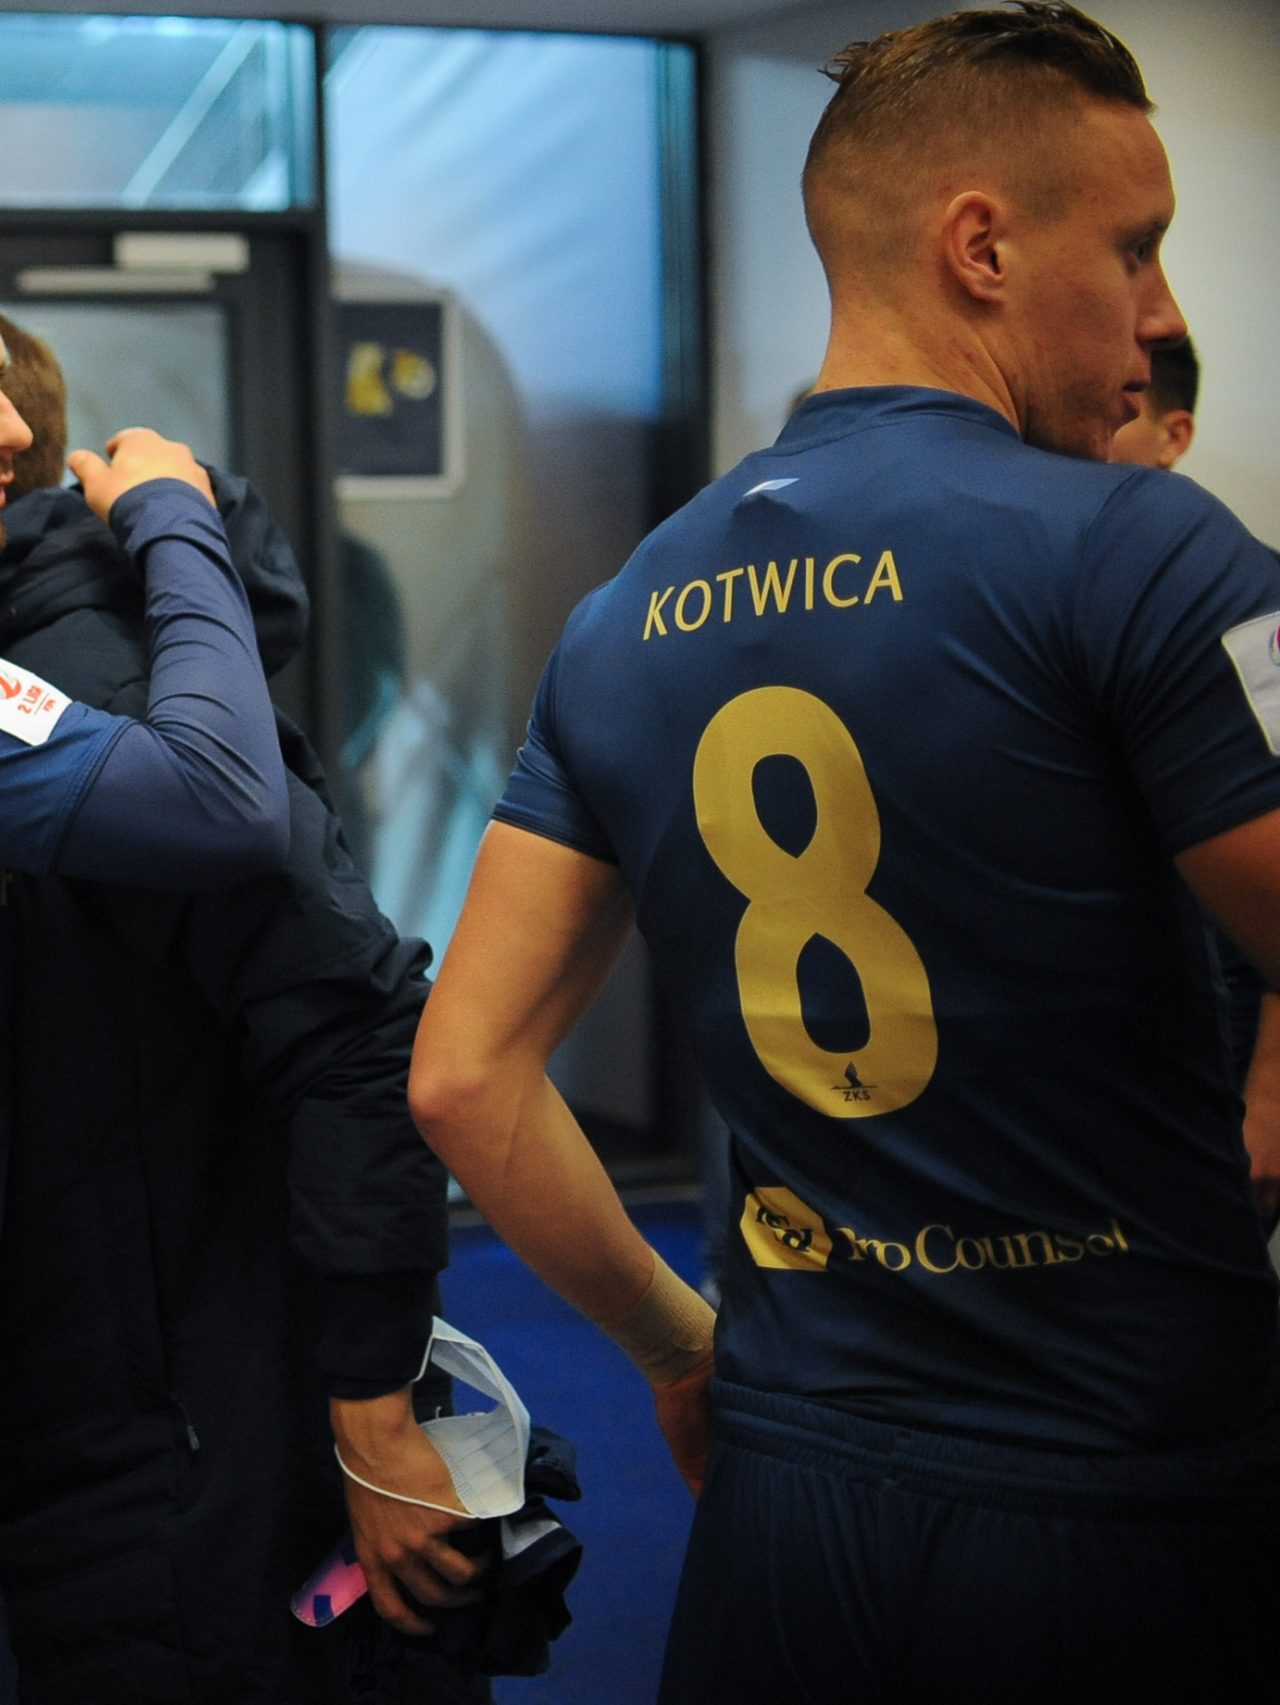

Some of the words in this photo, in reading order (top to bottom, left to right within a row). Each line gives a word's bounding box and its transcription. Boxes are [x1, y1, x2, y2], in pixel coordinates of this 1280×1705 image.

[642, 550, 904, 641] KOTWICA
[693, 685, 939, 1119] 8
[842, 1090, 871, 1102] ZKS
